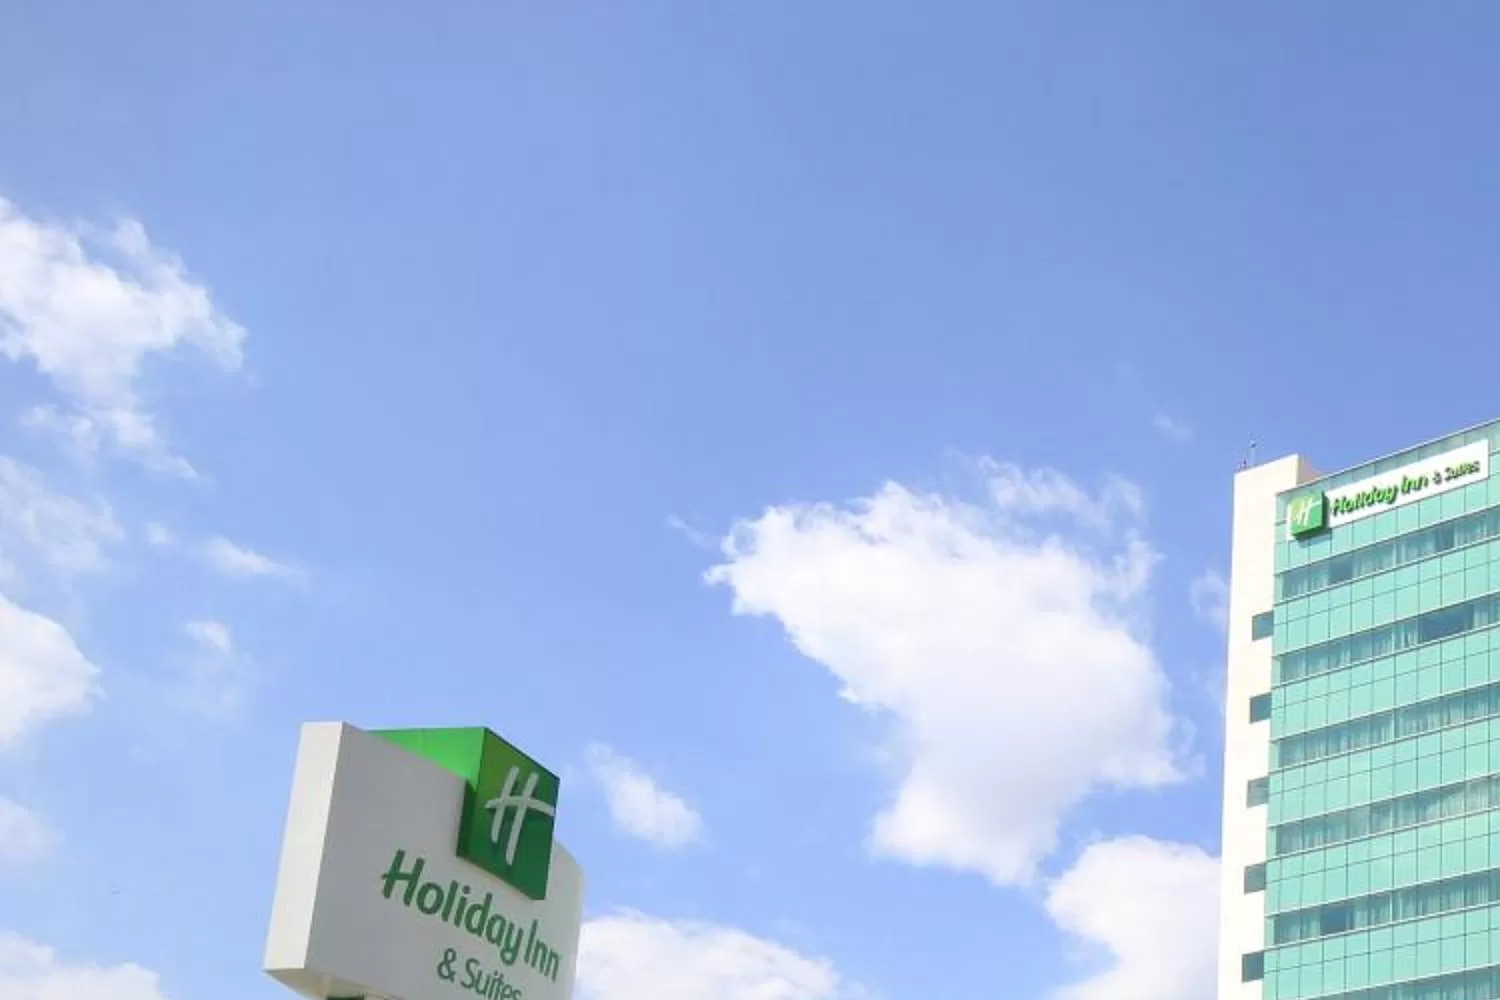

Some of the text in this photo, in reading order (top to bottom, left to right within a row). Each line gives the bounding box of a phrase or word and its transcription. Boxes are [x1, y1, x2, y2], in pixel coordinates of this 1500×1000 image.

[1332, 486, 1400, 516] Holiday
[1401, 474, 1429, 494] Inn
[381, 849, 560, 984] Holiday Inn
[437, 948, 456, 981] &
